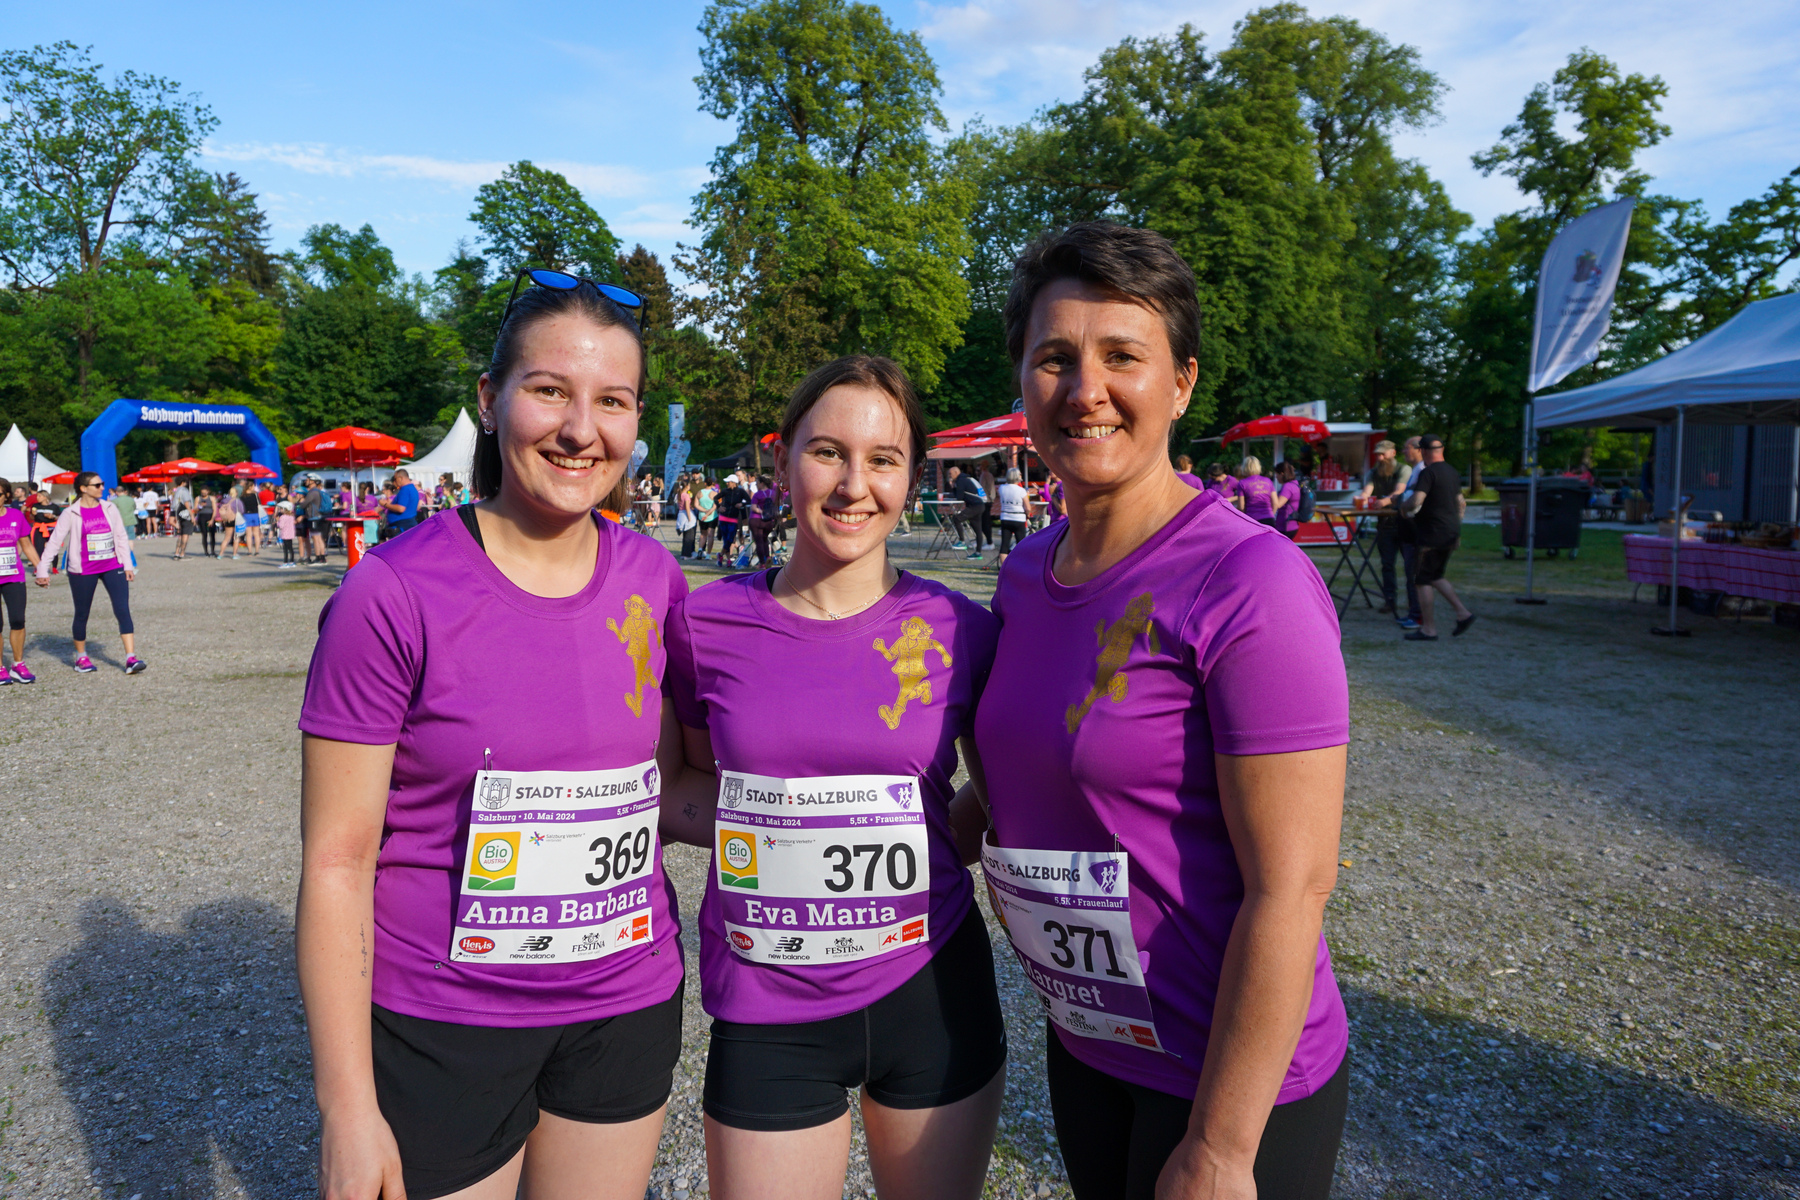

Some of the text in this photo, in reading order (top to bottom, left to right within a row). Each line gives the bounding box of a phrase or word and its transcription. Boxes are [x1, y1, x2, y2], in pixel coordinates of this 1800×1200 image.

[141, 406, 245, 425] Salzburger Nachrichten
[515, 786, 563, 799] STADT
[576, 780, 638, 799] SALZBURG
[746, 789, 784, 805] STADT
[797, 790, 878, 806] SALZBURG
[617, 798, 658, 816] 5,5K Frauenlauf
[478, 813, 516, 822] Salzburg
[720, 811, 750, 822] Salzburg
[755, 817, 764, 825] 10.
[782, 818, 801, 826] 2024
[850, 814, 920, 825] 5,5K Frauenlauf
[485, 846, 507, 859] Bio
[585, 826, 650, 886] 369
[728, 843, 747, 857] Bio
[823, 843, 916, 892] 370
[1007, 863, 1080, 882] SALZBURG
[462, 887, 647, 925] Anna Barbara
[1054, 896, 1123, 909] 5,5K Frauenlauf
[745, 899, 897, 927] Eva Maria
[616, 926, 630, 941] AK
[903, 925, 923, 936] SALZBURG
[462, 939, 492, 951] Hervis
[882, 932, 898, 945] AK
[571, 940, 605, 953] FESTINA
[826, 945, 864, 955] FESTINA
[1043, 920, 1128, 978] 371
[1018, 951, 1104, 1007] Margret
[1065, 1016, 1098, 1032] FESTINA
[1114, 1026, 1131, 1038] AK
